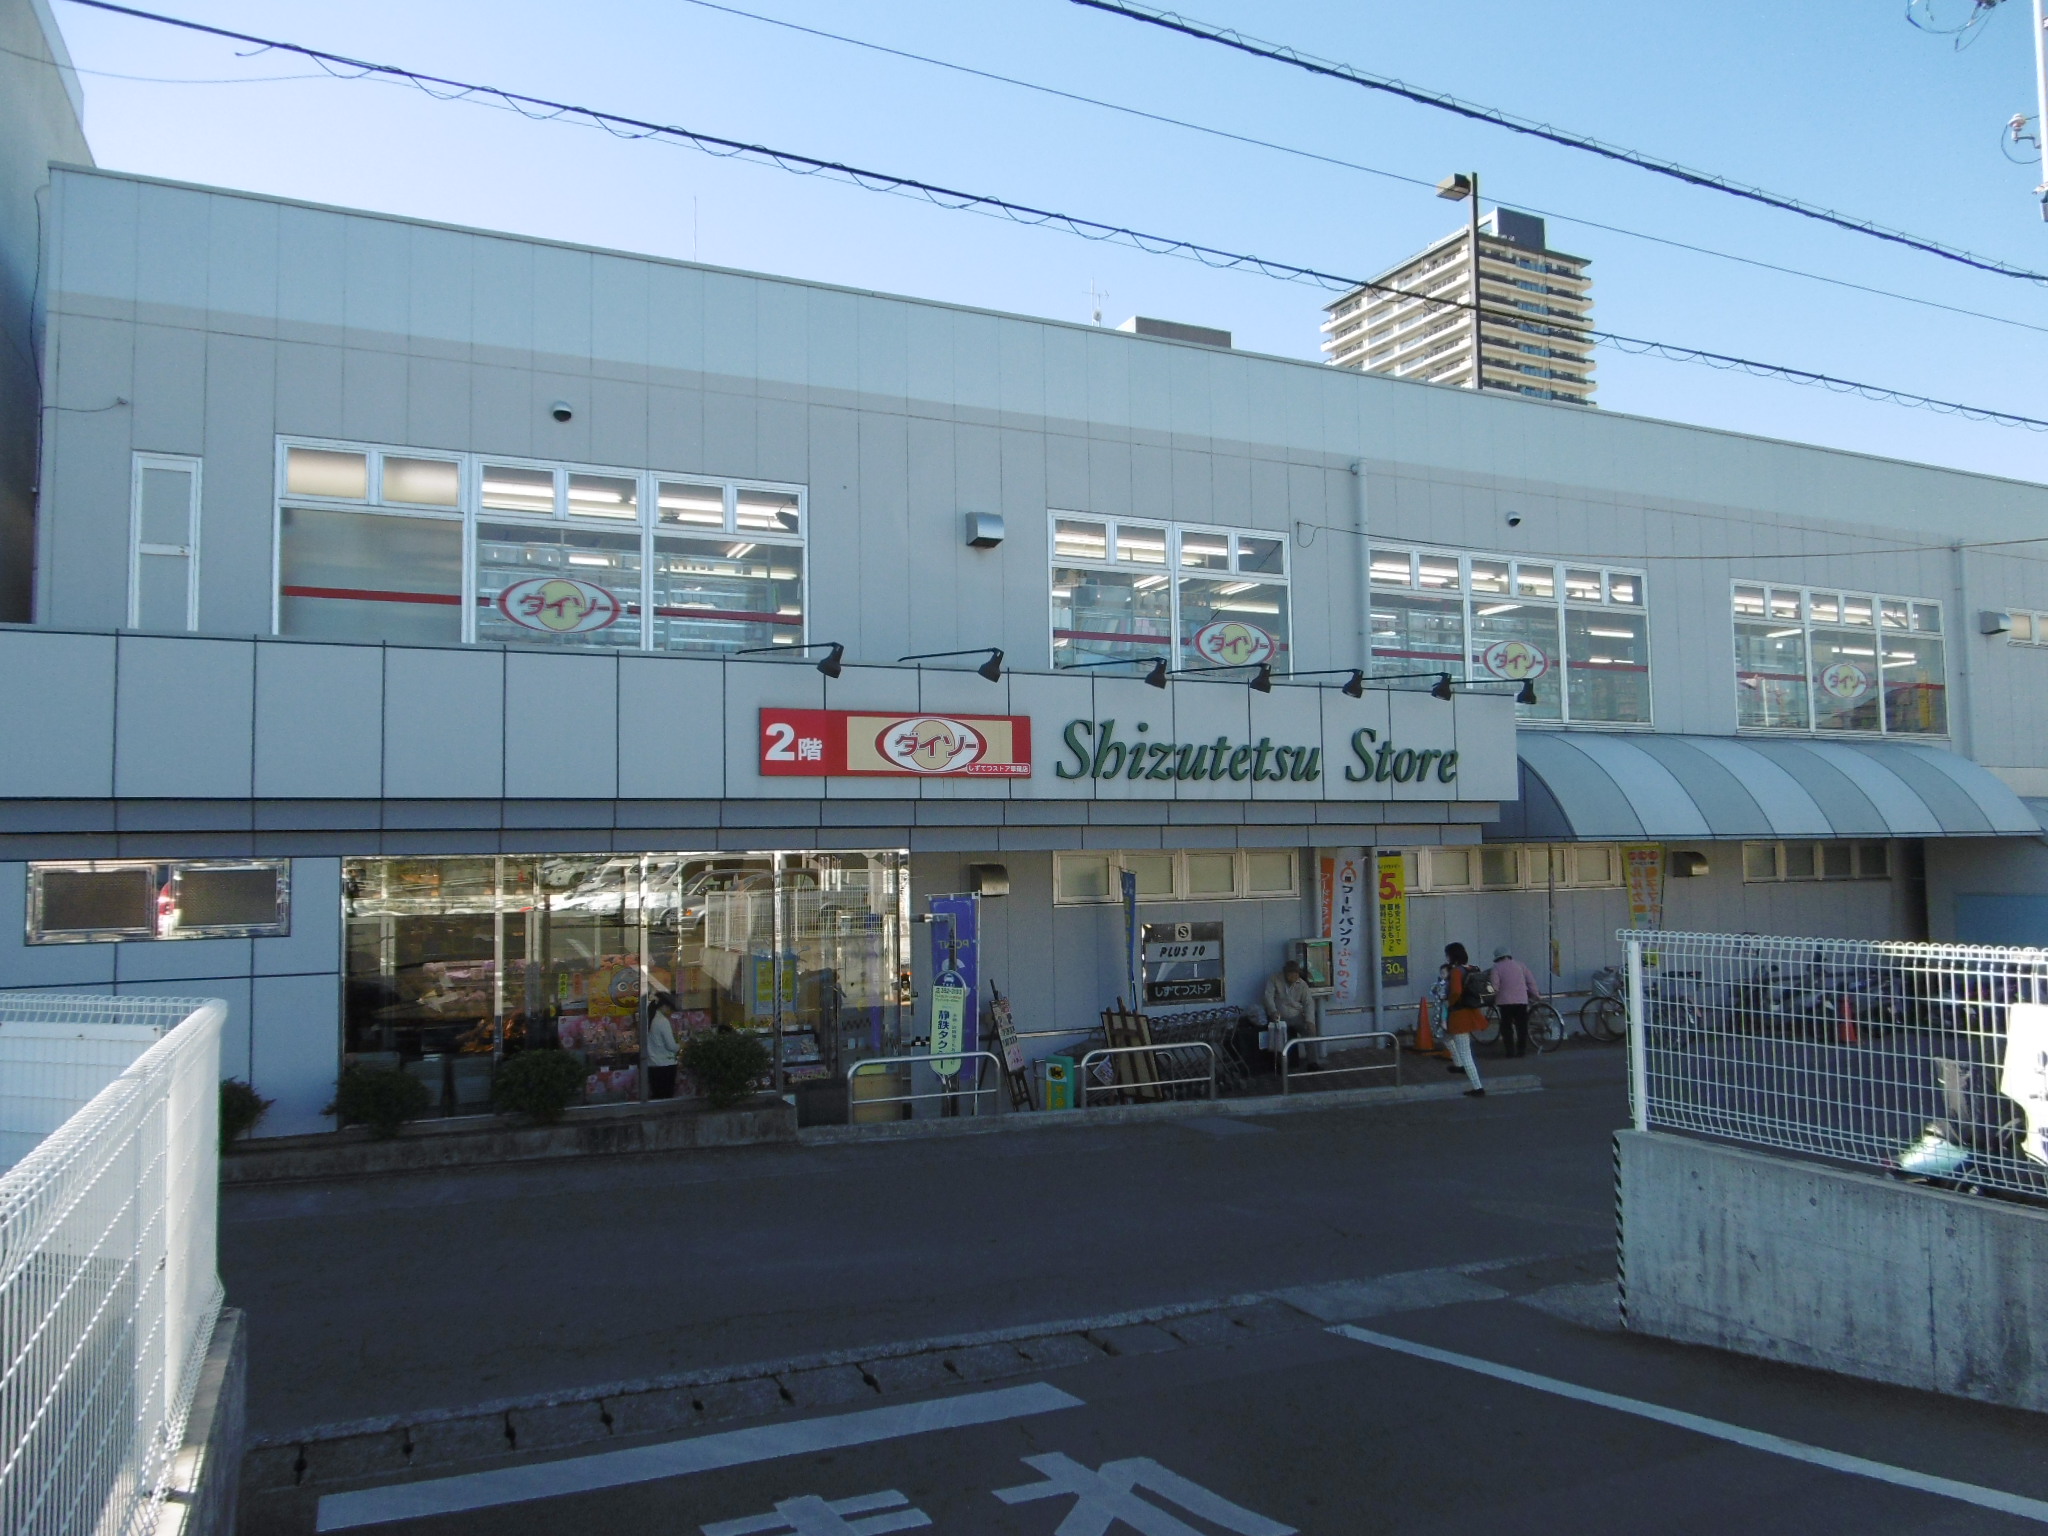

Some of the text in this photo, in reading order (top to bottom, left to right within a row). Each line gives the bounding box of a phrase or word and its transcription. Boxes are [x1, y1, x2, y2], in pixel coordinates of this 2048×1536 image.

[520, 590, 610, 617] ダイソー
[1208, 634, 1269, 655] ダイソー
[1494, 652, 1544, 671] ダイソー
[1830, 674, 1866, 689] ダイソー
[765, 723, 823, 761] 2階
[895, 732, 979, 757] ダイソー
[1056, 718, 1460, 784] Shizutetsu Store
[1160, 945, 1206, 957] PLUS 10
[1155, 983, 1212, 997] しずてつストア
